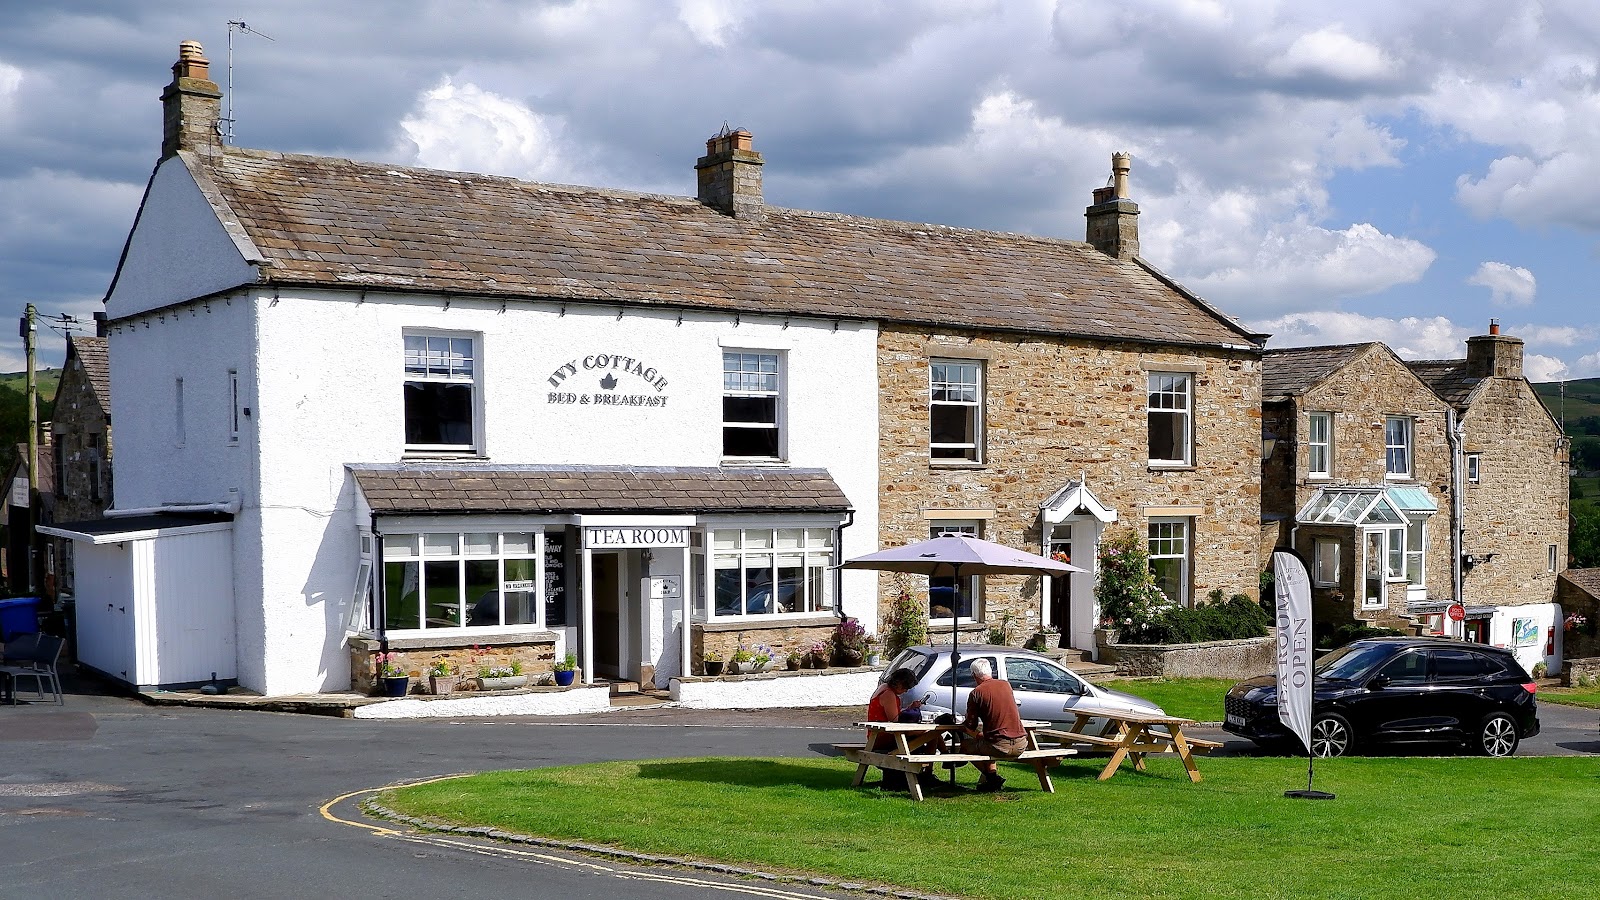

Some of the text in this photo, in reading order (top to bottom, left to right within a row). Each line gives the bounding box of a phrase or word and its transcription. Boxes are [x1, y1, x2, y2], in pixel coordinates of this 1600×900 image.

[547, 353, 668, 392] IVY COTTAGE
[547, 392, 669, 407] BED & BREAKFAST
[591, 528, 685, 544] TEA ROOM
[1278, 592, 1290, 665] ROOM
[1293, 618, 1307, 689] OPEN
